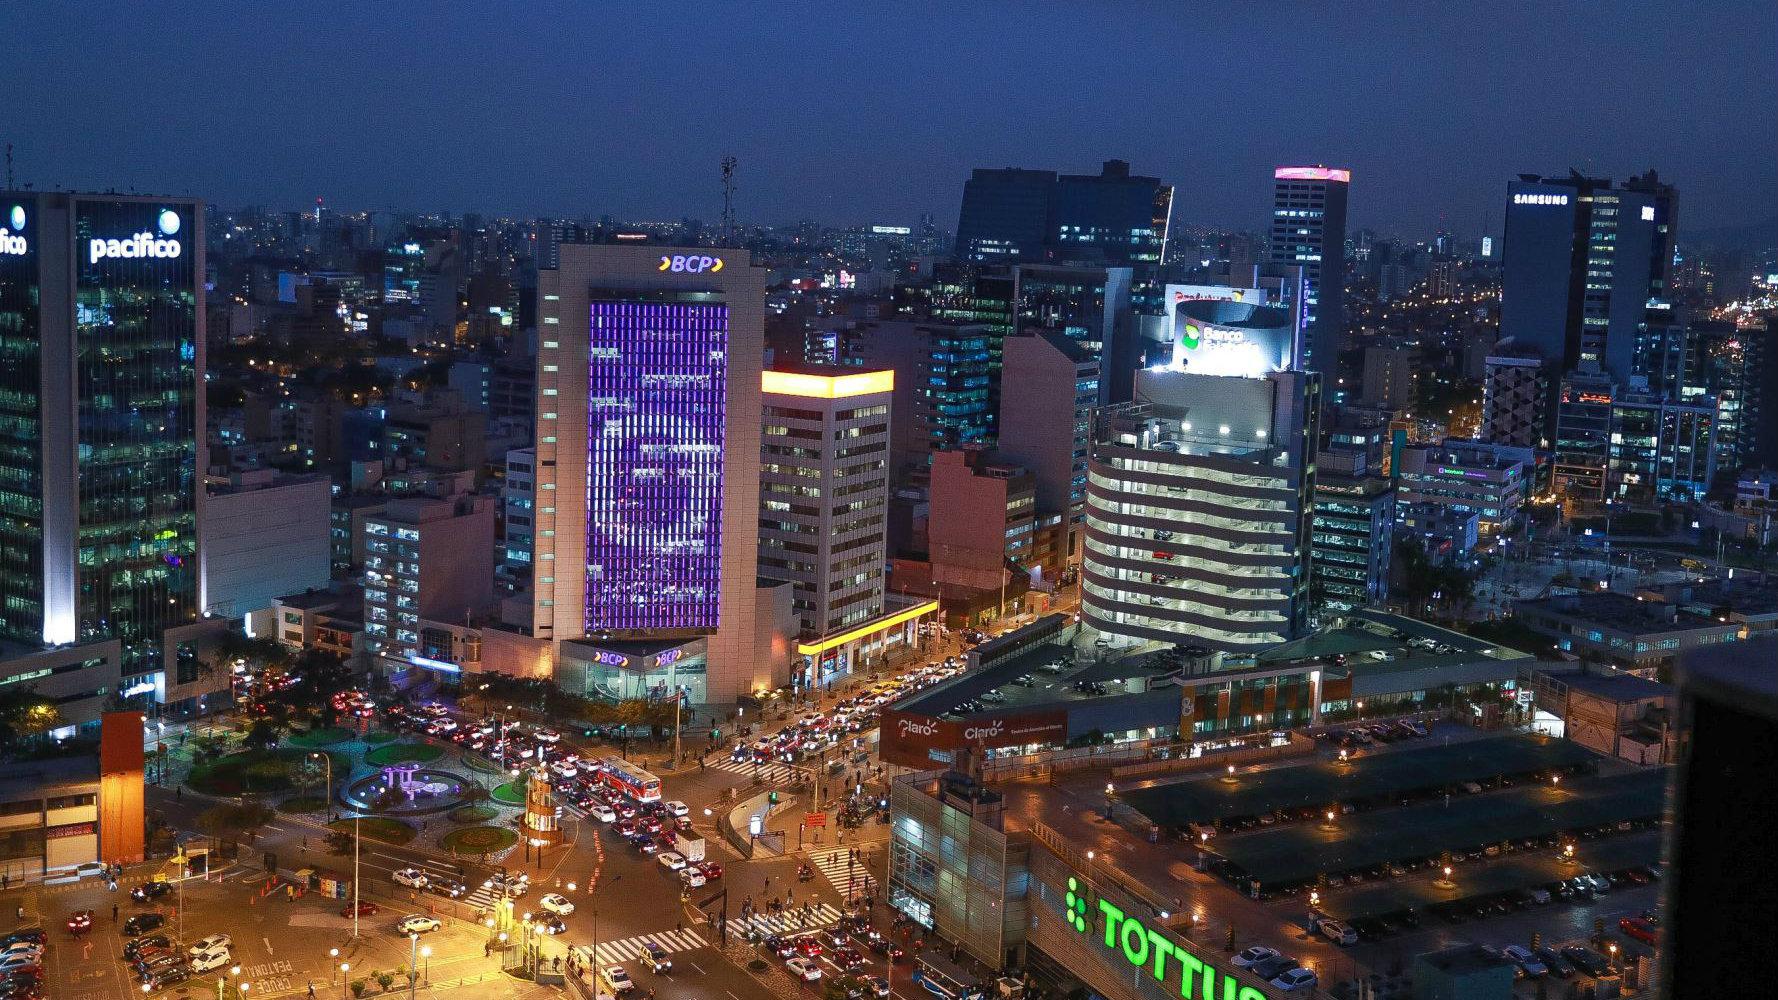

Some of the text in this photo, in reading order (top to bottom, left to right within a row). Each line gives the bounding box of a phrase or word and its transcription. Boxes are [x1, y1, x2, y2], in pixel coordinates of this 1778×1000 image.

[1514, 194, 1568, 205] SAMSUNG
[670, 255, 713, 273] BCP
[600, 651, 623, 667] BCP
[660, 649, 678, 666] BCP
[899, 719, 932, 736] Claro
[964, 726, 998, 740] Claro
[1099, 898, 1268, 1000] TOTTU
[257, 977, 292, 994] CRUCE
